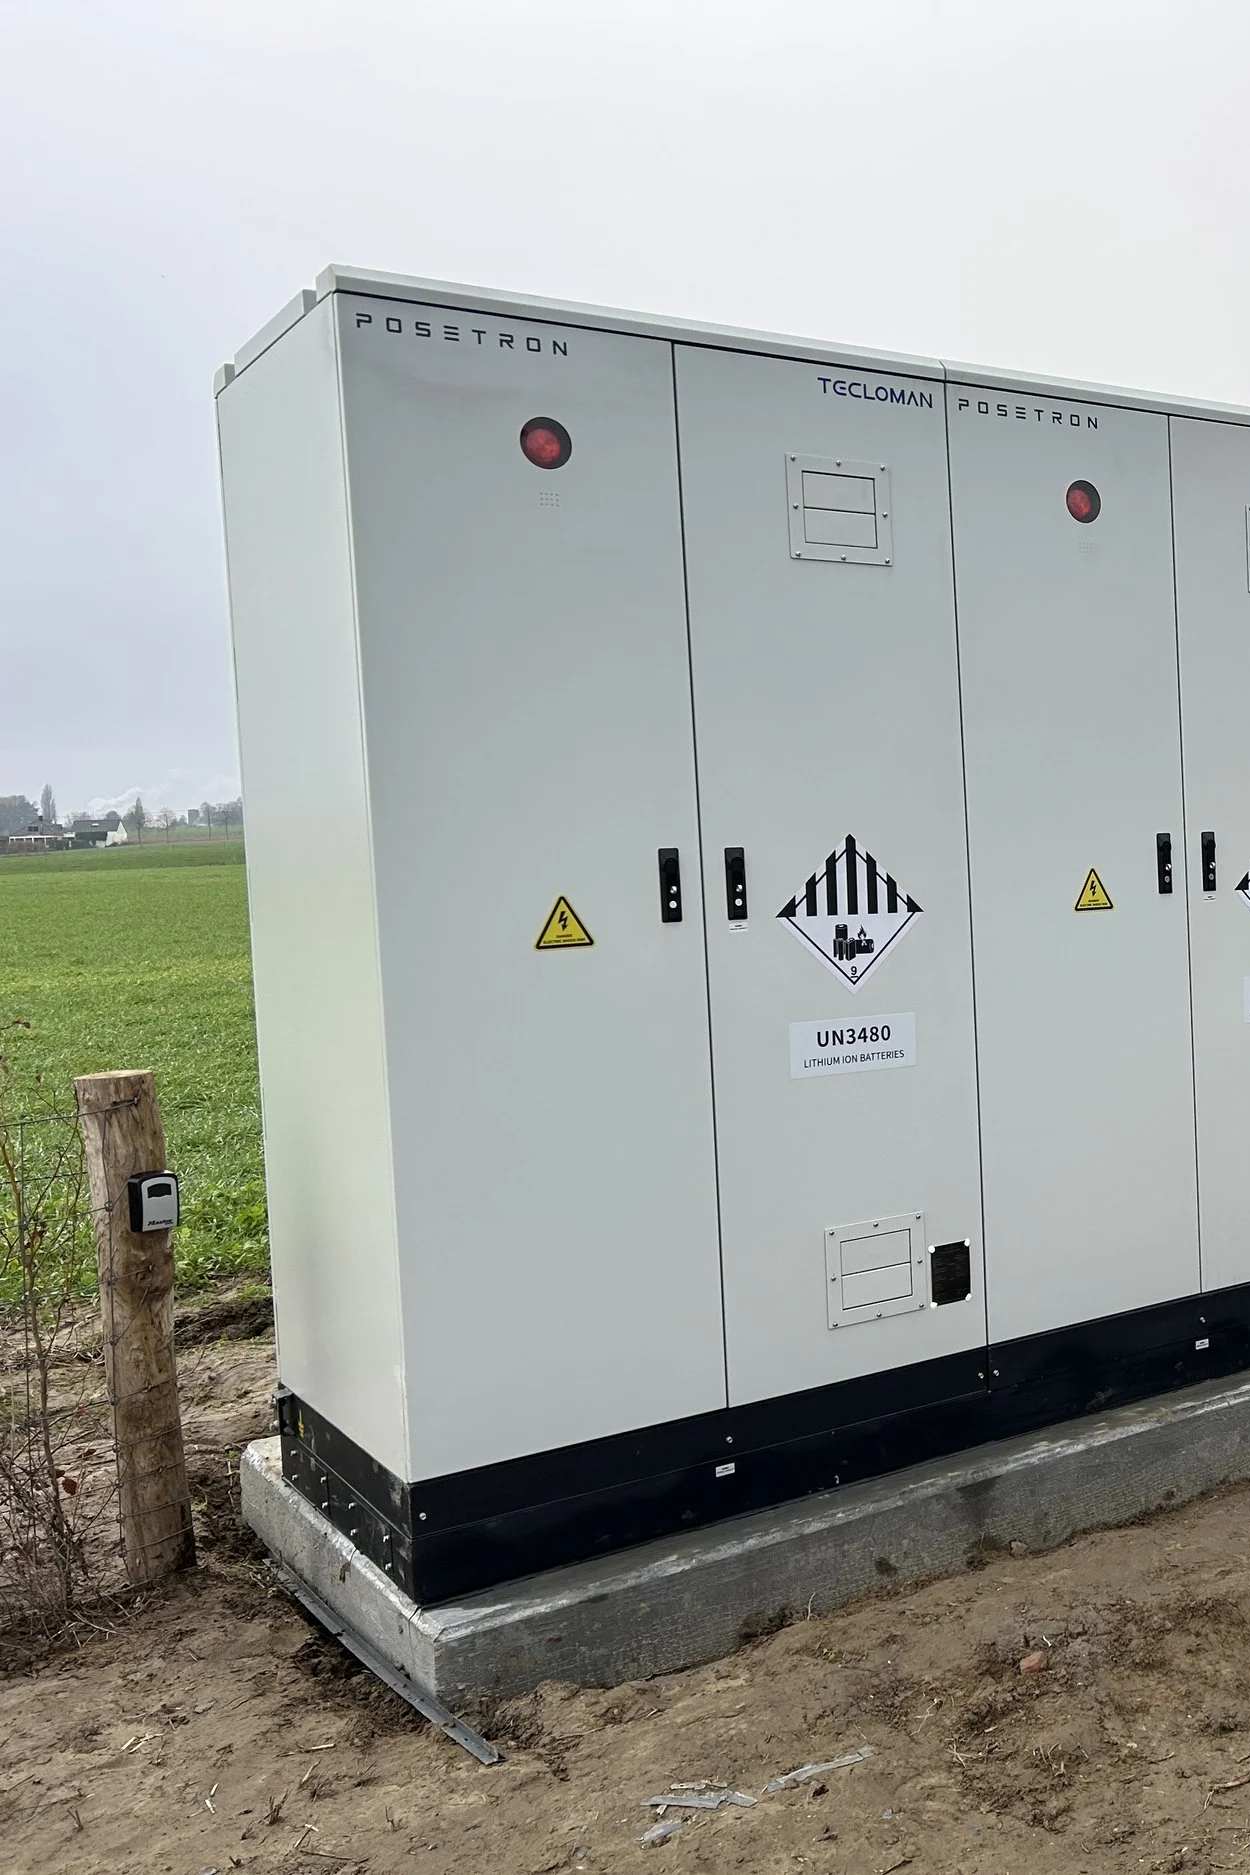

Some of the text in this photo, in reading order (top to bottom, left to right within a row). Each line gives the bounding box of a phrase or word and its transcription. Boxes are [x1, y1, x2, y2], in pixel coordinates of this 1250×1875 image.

[356, 313, 568, 356] POSETRON
[818, 377, 933, 409] TECLOMAN
[958, 399, 1098, 430] POSETRON
[851, 966, 858, 975] 9
[816, 1025, 891, 1048] UN3480
[803, 1049, 905, 1069] LITHIUM ION BATTERIES
